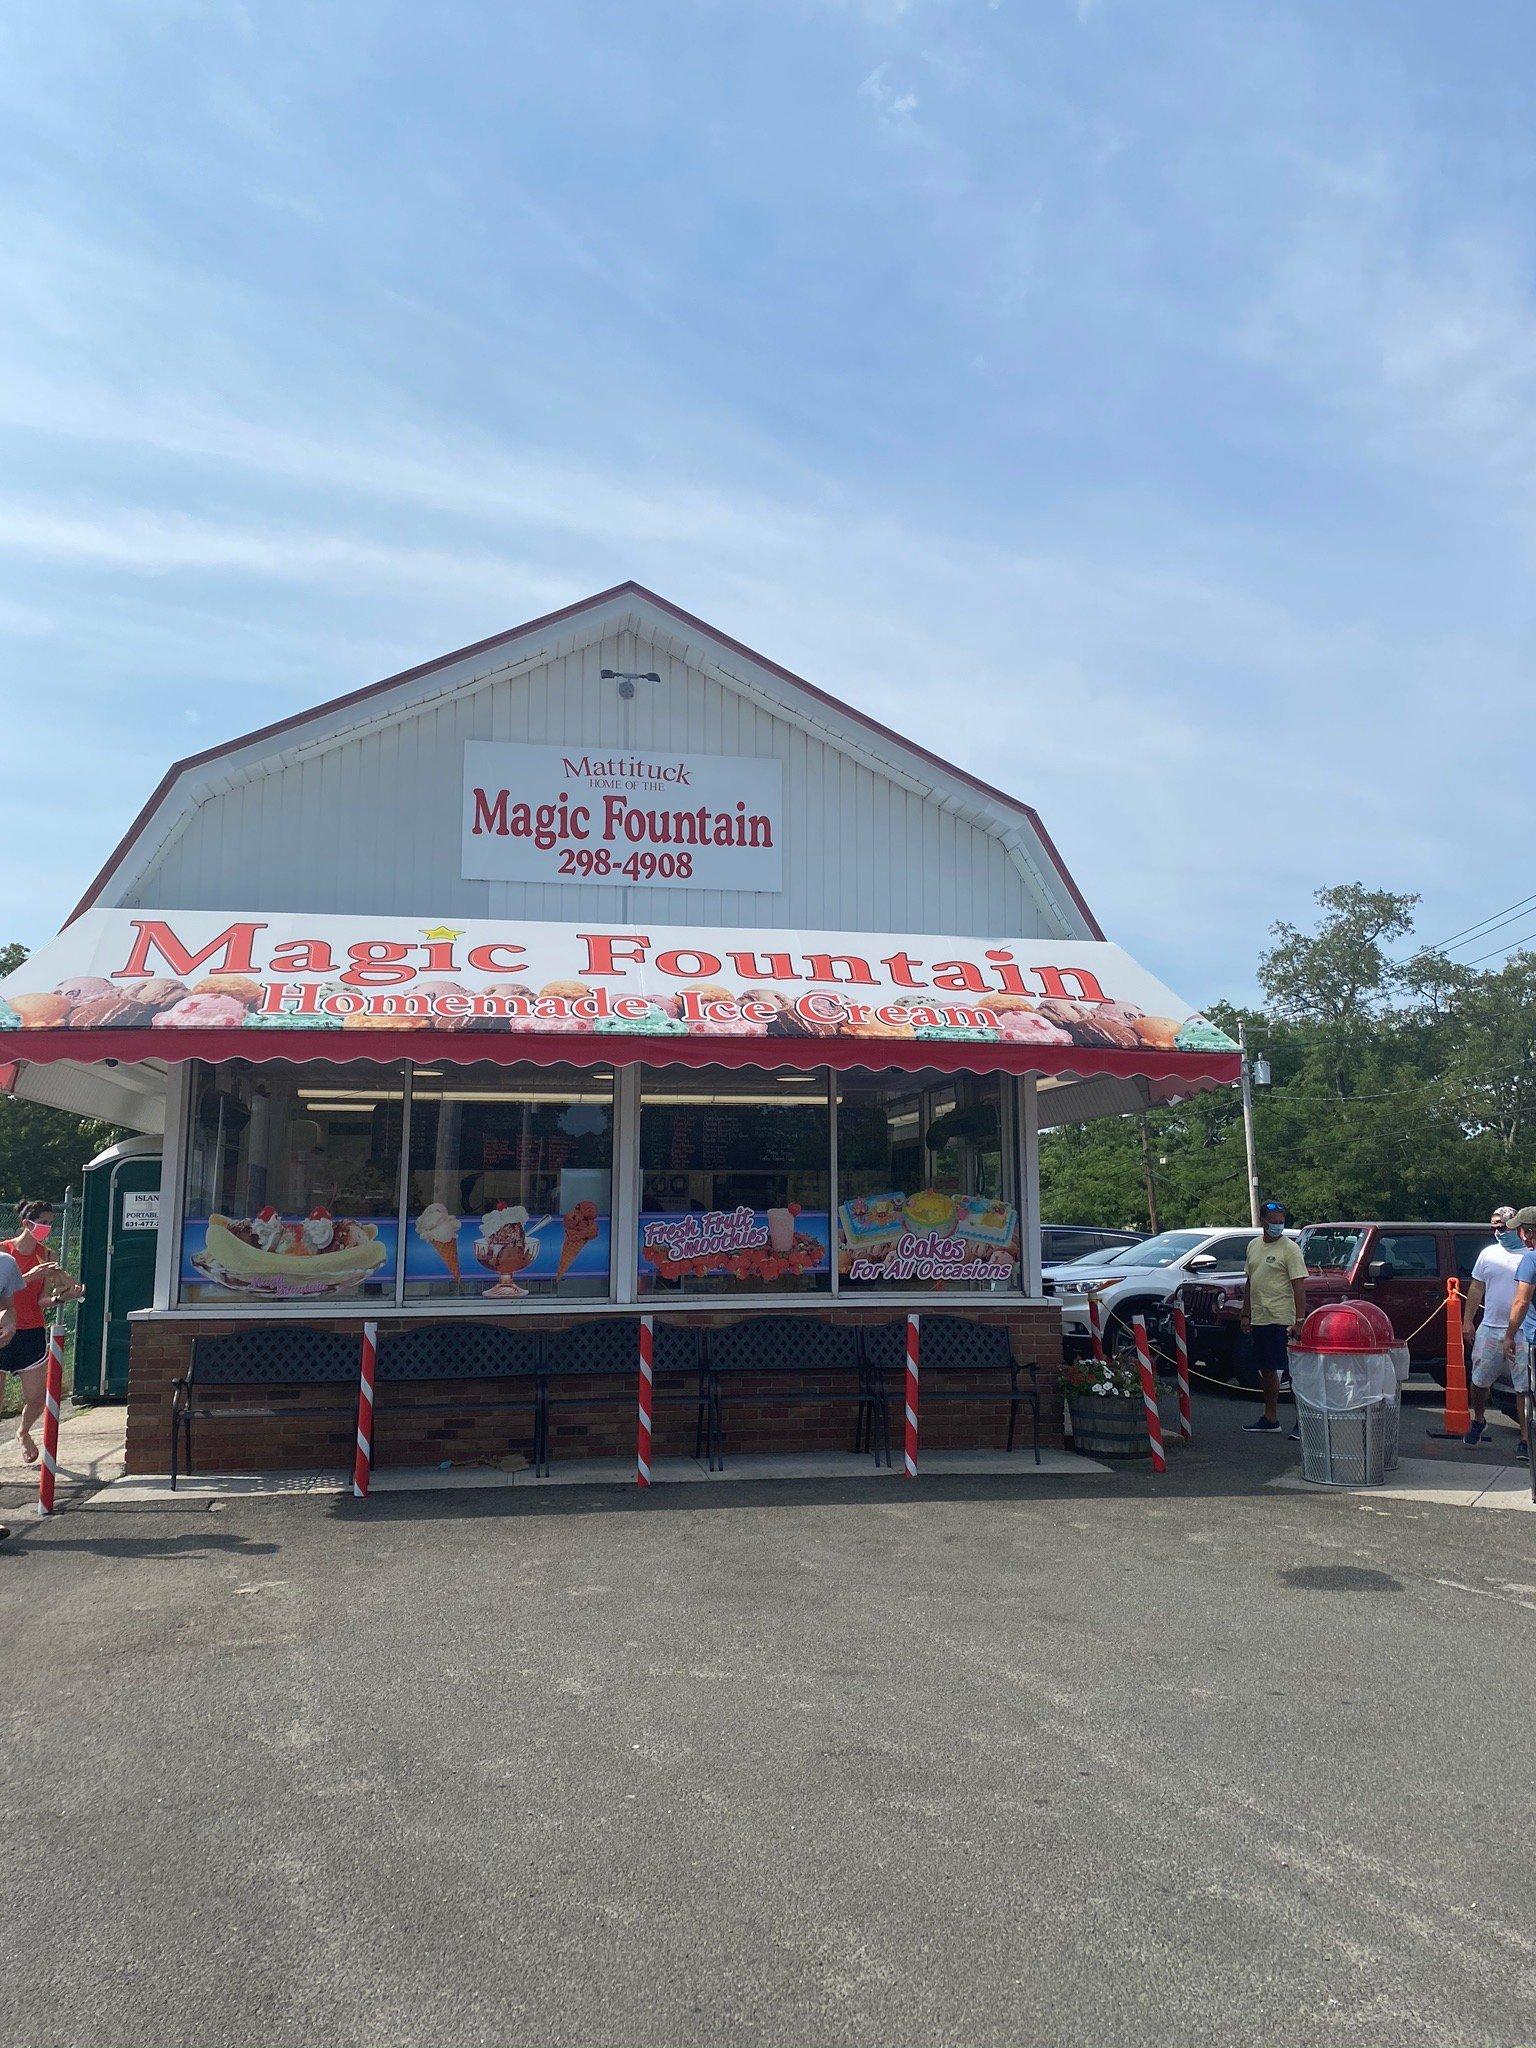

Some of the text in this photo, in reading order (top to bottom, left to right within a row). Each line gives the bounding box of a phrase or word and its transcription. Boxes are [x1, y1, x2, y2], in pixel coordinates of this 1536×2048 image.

[561, 756, 692, 786] Mattituck
[589, 778, 665, 792] HOME OF THE
[472, 788, 774, 850] Magic Fountain
[557, 848, 693, 882] 298-4908
[111, 919, 1115, 1005] Magic Fountain
[257, 981, 1004, 1029] Homemade Ice Cream
[643, 1205, 755, 1247] Fresh Fruit
[668, 1226, 769, 1262] Smoothies
[898, 1231, 966, 1263] Cakes
[850, 1258, 1012, 1281] For All Occasions
